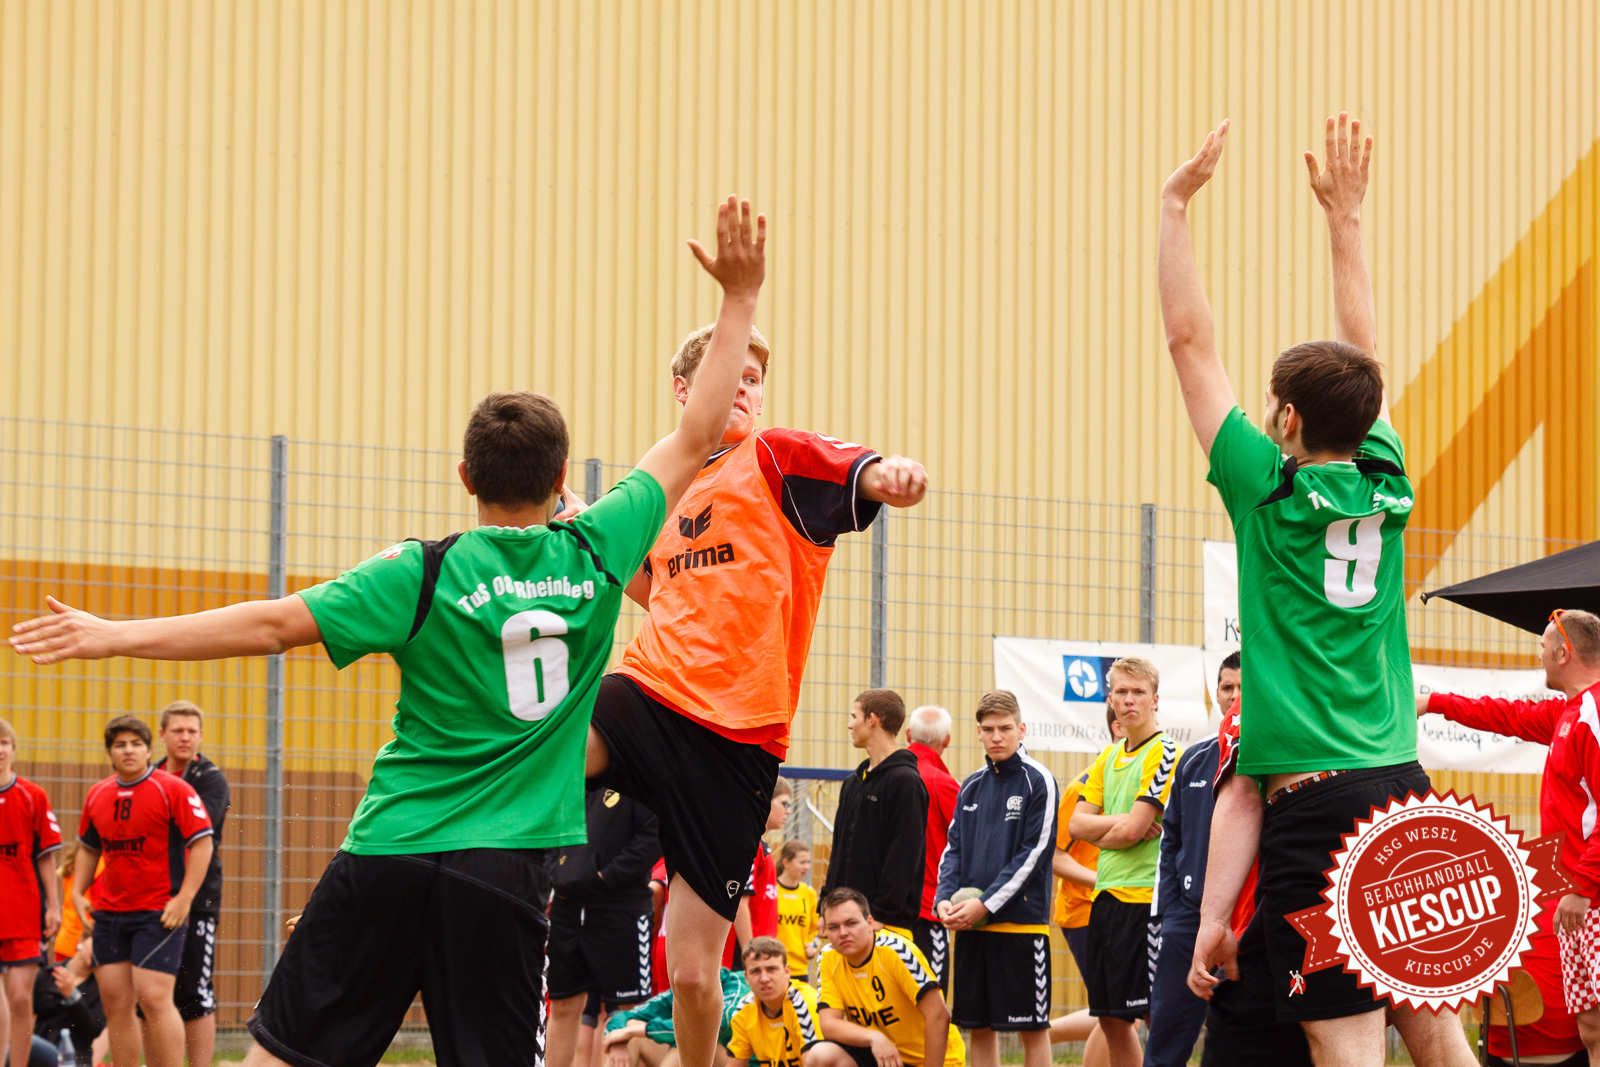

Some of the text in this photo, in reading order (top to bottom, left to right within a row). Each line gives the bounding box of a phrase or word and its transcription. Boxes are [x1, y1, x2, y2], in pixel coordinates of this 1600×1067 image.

[667, 543, 735, 579] erima
[1323, 511, 1386, 609] 9
[457, 582, 491, 614] TuS
[501, 610, 570, 722] 6
[114, 798, 132, 821] 18
[196, 920, 206, 937] 3
[778, 914, 806, 928] RWE
[871, 975, 886, 1002] 9
[847, 1005, 900, 1027] RWE
